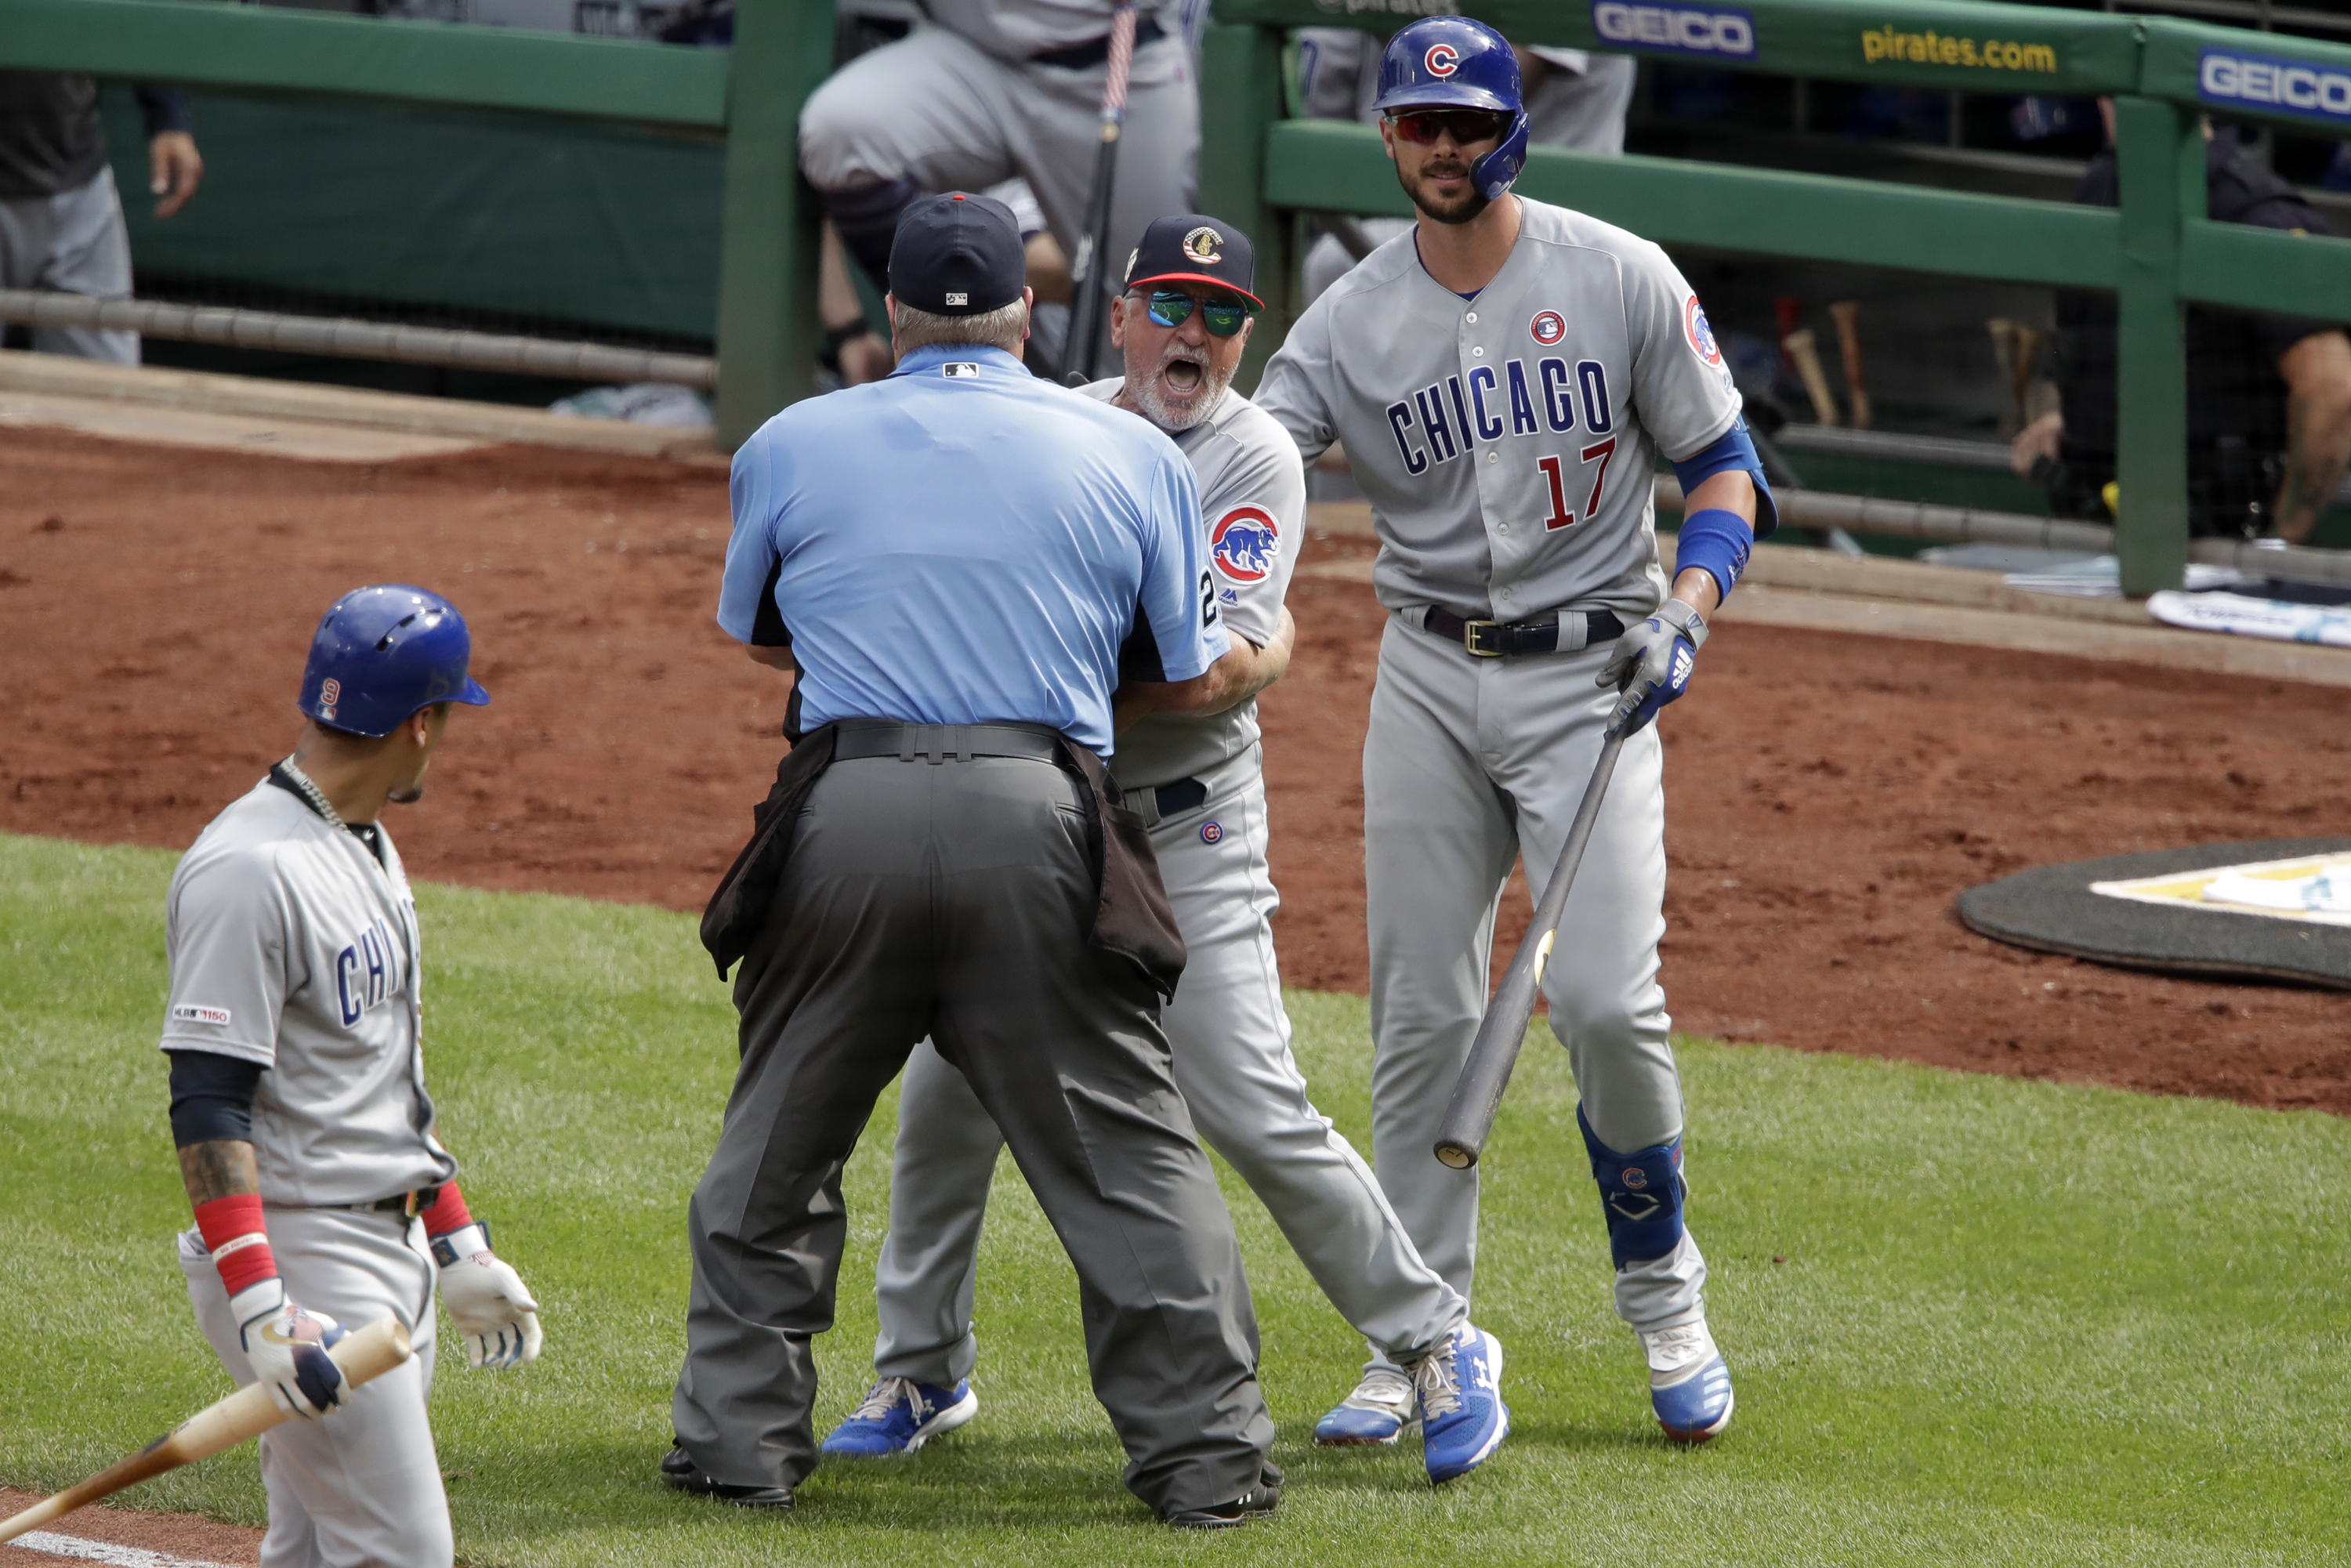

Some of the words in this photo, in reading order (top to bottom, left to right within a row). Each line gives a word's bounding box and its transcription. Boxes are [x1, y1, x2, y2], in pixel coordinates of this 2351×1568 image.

[1594, 2, 1754, 55] GEICO
[1861, 24, 2057, 73] pirates.com
[1425, 43, 1459, 78] C
[2201, 55, 2351, 114] GEICO
[1386, 357, 1614, 476] CHICAGO
[1536, 433, 1617, 533] 17
[1672, 660, 1694, 690] adida
